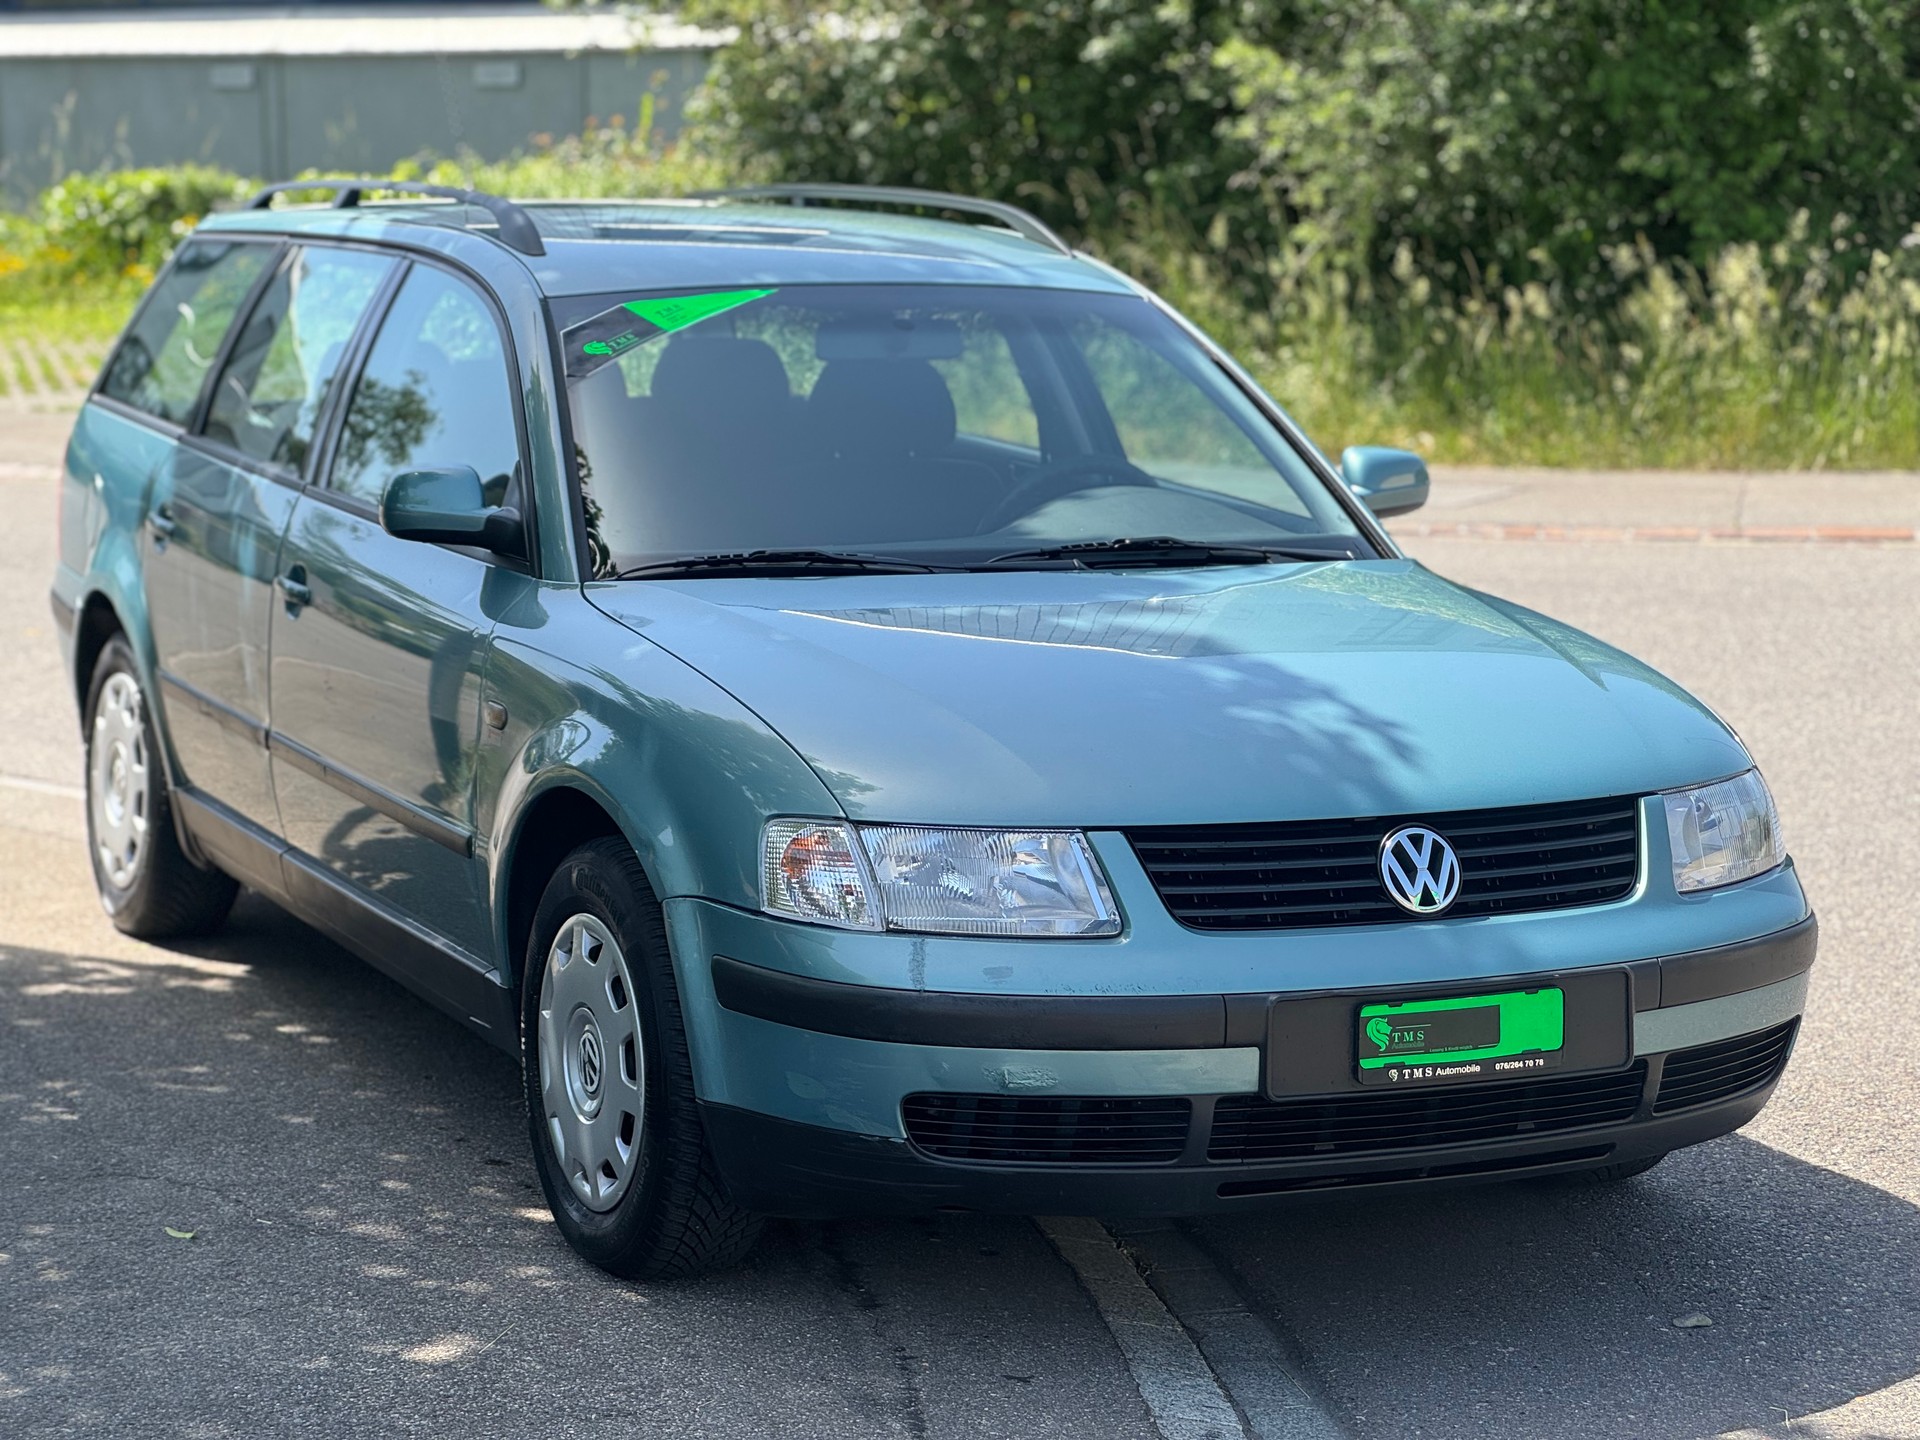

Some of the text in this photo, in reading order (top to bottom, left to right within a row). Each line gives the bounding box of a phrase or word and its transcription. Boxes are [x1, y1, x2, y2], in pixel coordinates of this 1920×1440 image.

[1402, 1058, 1544, 1079] TMS Automobile 076/264 70 78
